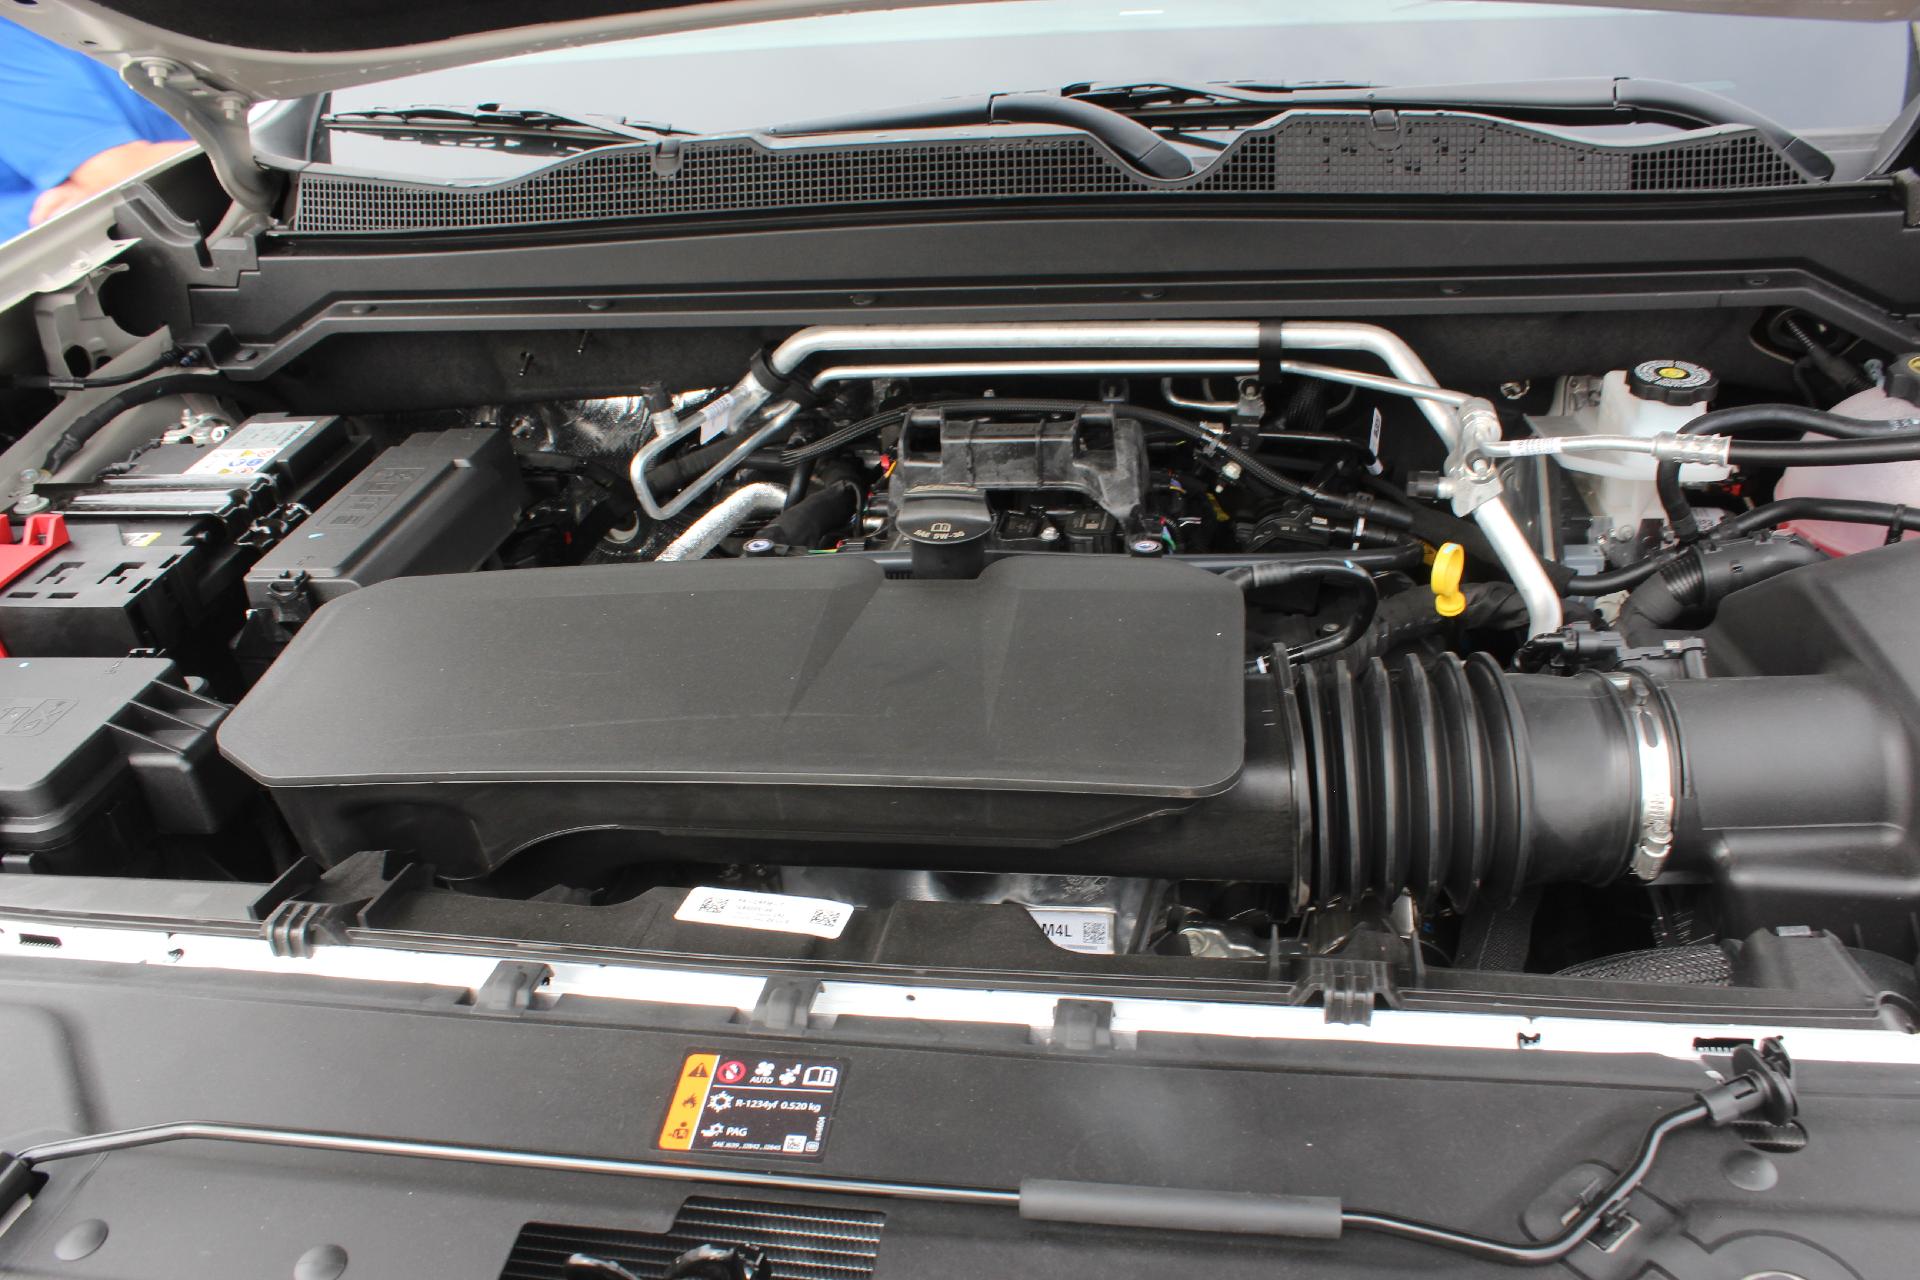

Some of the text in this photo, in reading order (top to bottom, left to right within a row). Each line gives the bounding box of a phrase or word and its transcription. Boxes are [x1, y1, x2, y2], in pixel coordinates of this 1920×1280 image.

[1042, 924, 1072, 937] M4L
[750, 1076, 774, 1084] AUTO
[735, 1099, 822, 1113] R-1234yf 0.520 kg
[726, 1126, 748, 1137] PAG
